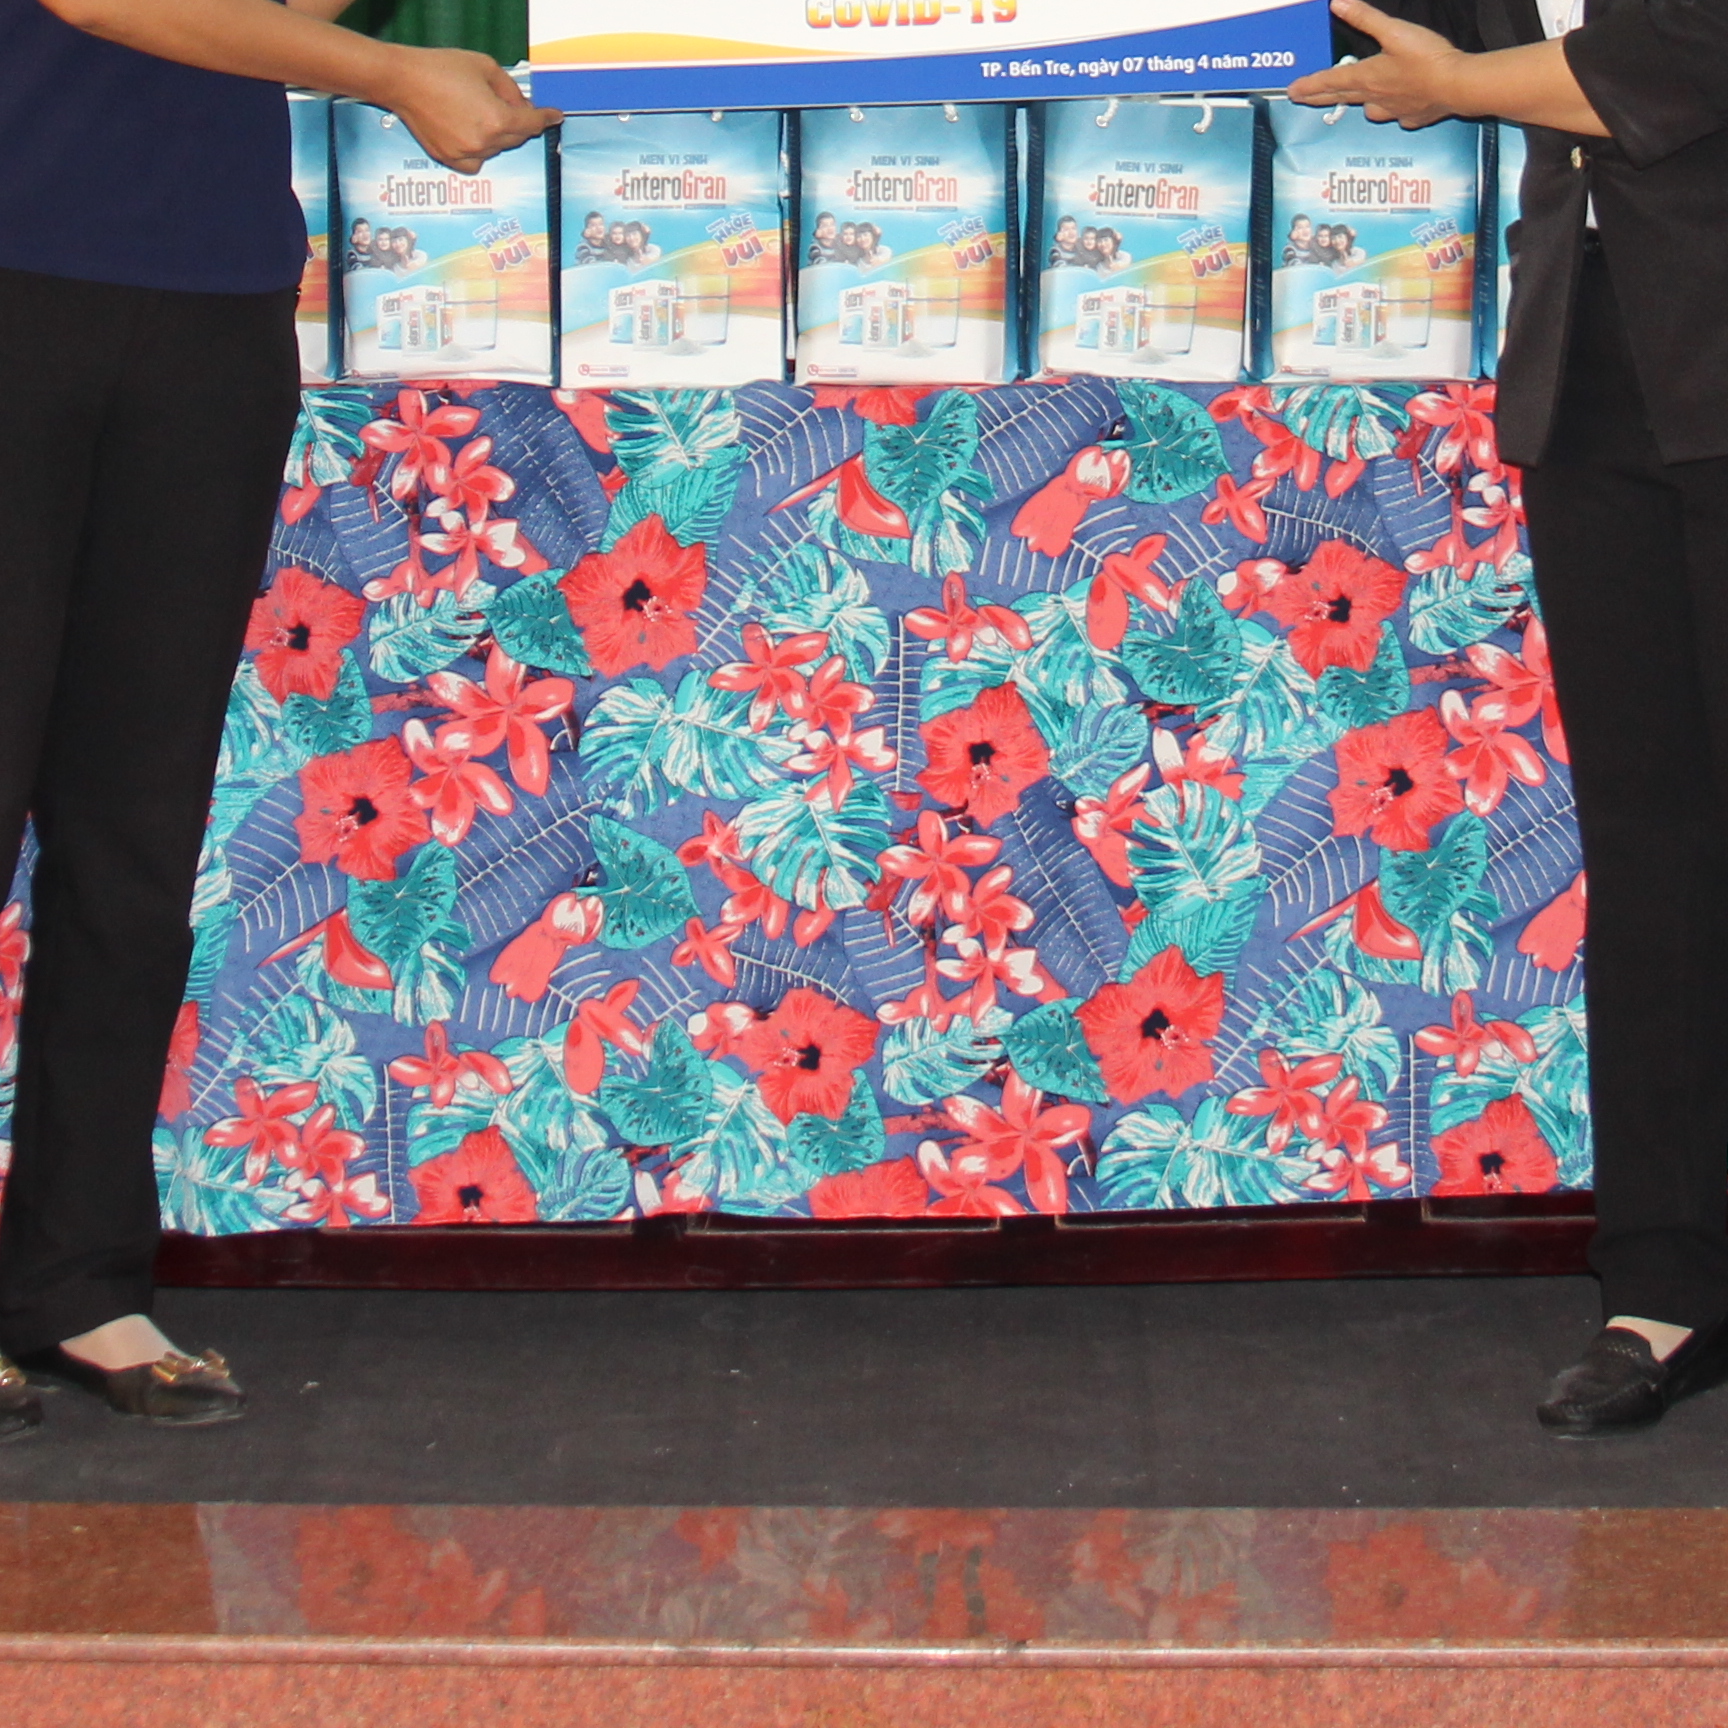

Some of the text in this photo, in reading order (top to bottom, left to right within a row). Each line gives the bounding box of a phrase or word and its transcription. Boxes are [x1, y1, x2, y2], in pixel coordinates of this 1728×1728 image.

[980, 51, 1295, 78] TP. Bến Tre, ngày 07 tháng 4 năm 2020
[387, 173, 492, 208] EnteroGran
[622, 169, 726, 200] EnteroGran
[853, 170, 958, 202] EnteroGran
[1096, 175, 1199, 211] EnteroGran
[1328, 171, 1431, 205] EnteroGran
